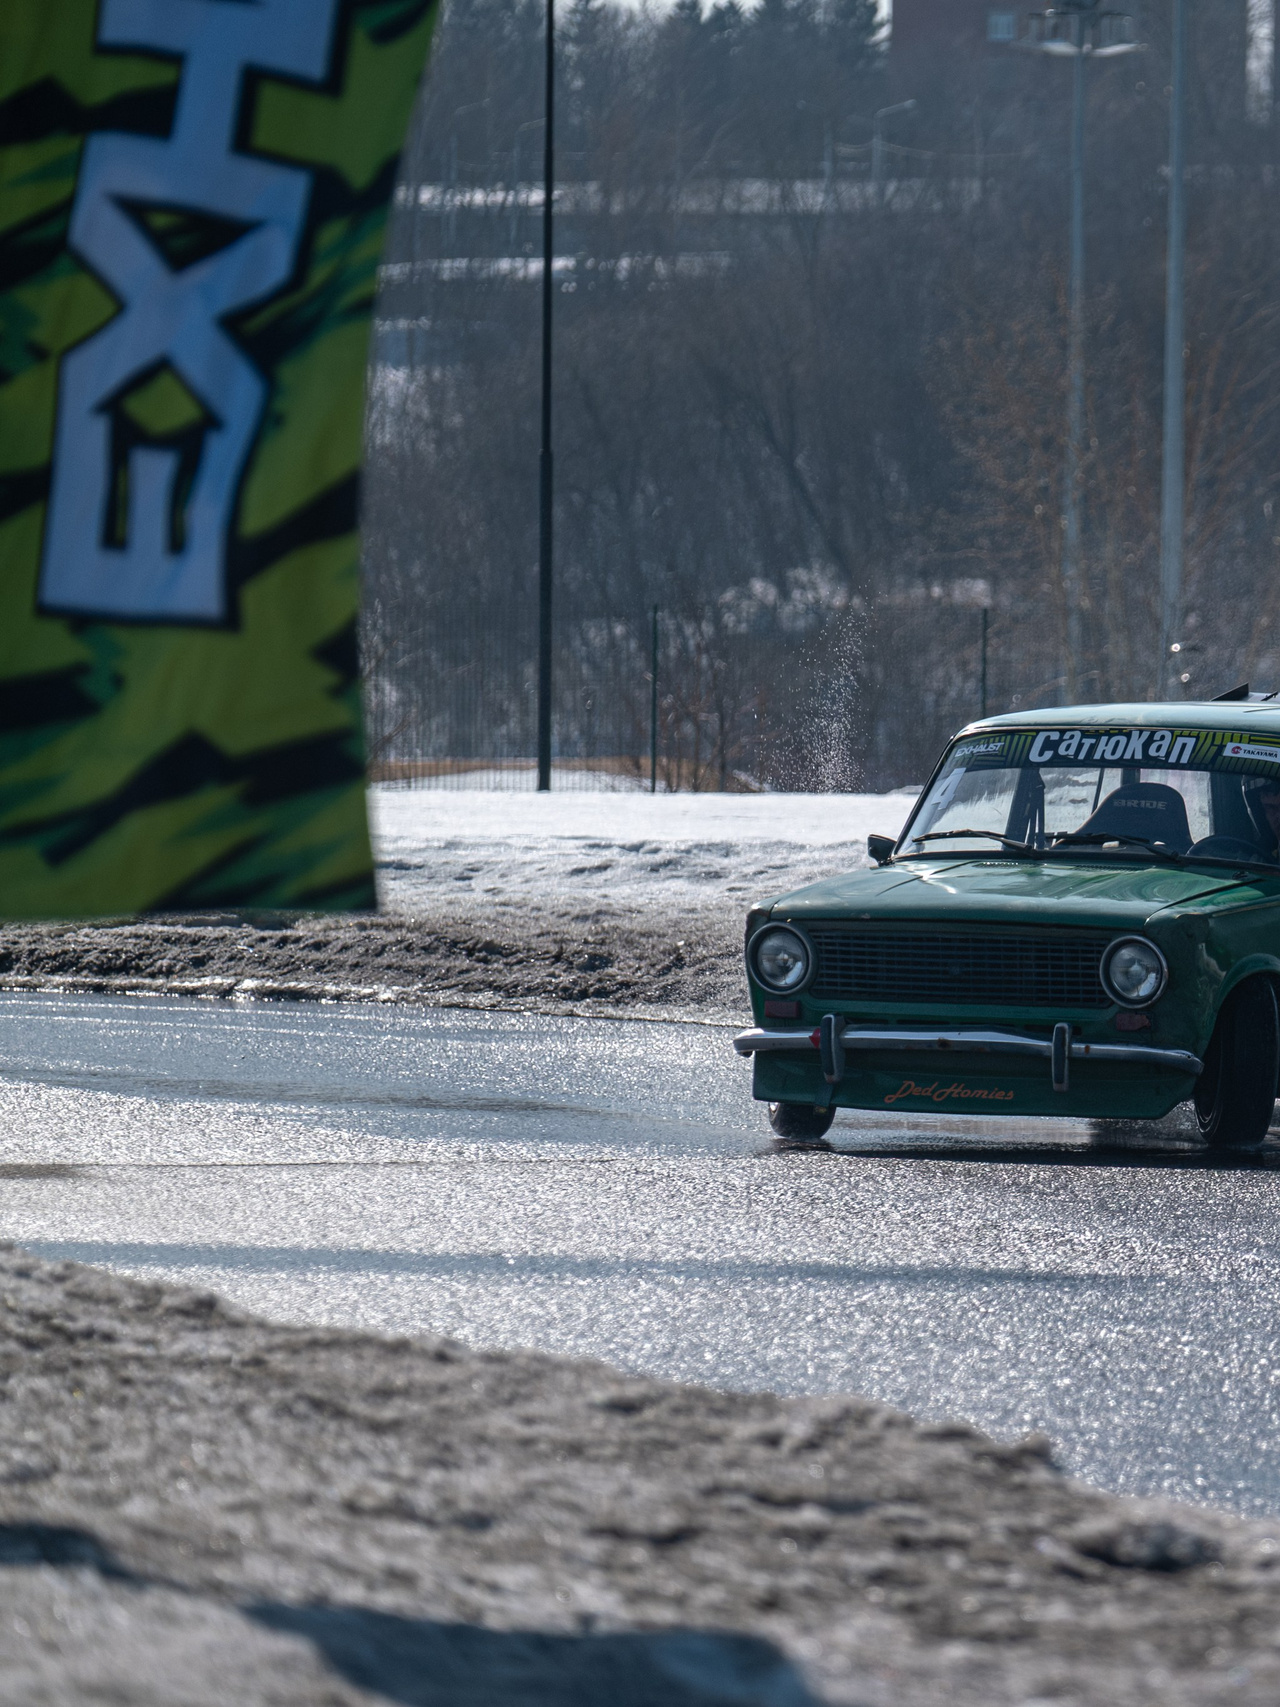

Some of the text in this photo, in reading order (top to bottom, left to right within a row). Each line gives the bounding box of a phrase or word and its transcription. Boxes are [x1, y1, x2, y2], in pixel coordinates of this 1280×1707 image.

[955, 743, 1004, 757] EXHAUST
[1243, 749, 1278, 758] TAKAYAMA
[1113, 800, 1168, 810] BRIDE
[932, 1083, 1014, 1101] Homies
